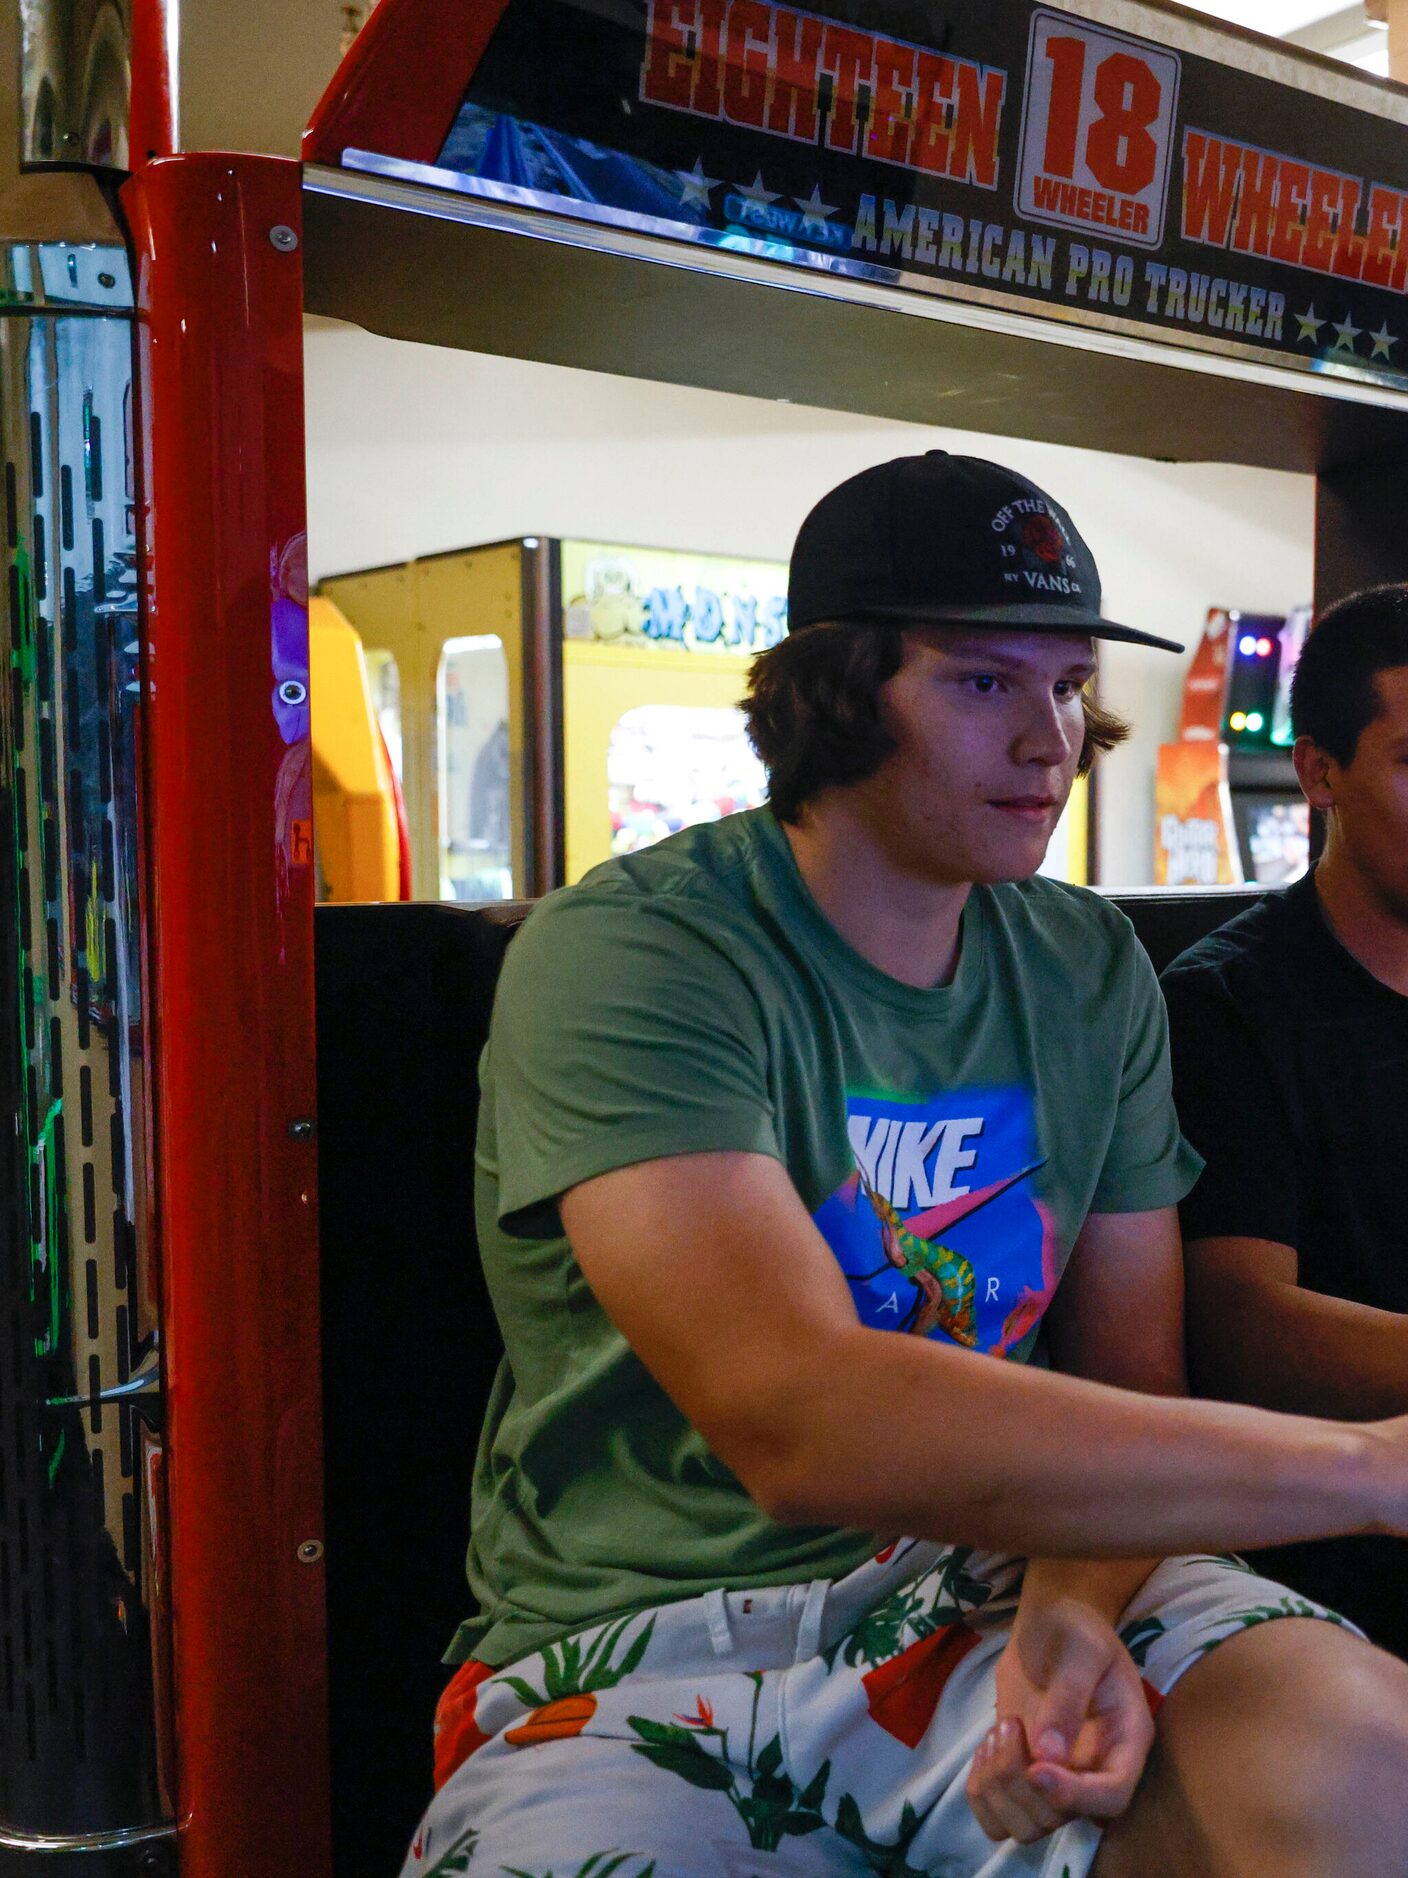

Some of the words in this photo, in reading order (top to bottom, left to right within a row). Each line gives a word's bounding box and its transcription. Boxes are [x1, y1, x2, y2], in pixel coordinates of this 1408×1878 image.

[638, 0, 1008, 191] EIGHTEEN
[1043, 35, 1162, 196] 18
[1033, 176, 1150, 236] WHEELER
[851, 193, 1056, 290] AMERICAN
[1065, 243, 1134, 307] PRO
[1144, 262, 1287, 341] TRUCKER
[991, 505, 1015, 532] OFF
[1011, 499, 1046, 514] THE
[1001, 544, 1016, 557] 19
[1023, 571, 1071, 594] VANS
[847, 1114, 985, 1210] NIKE
